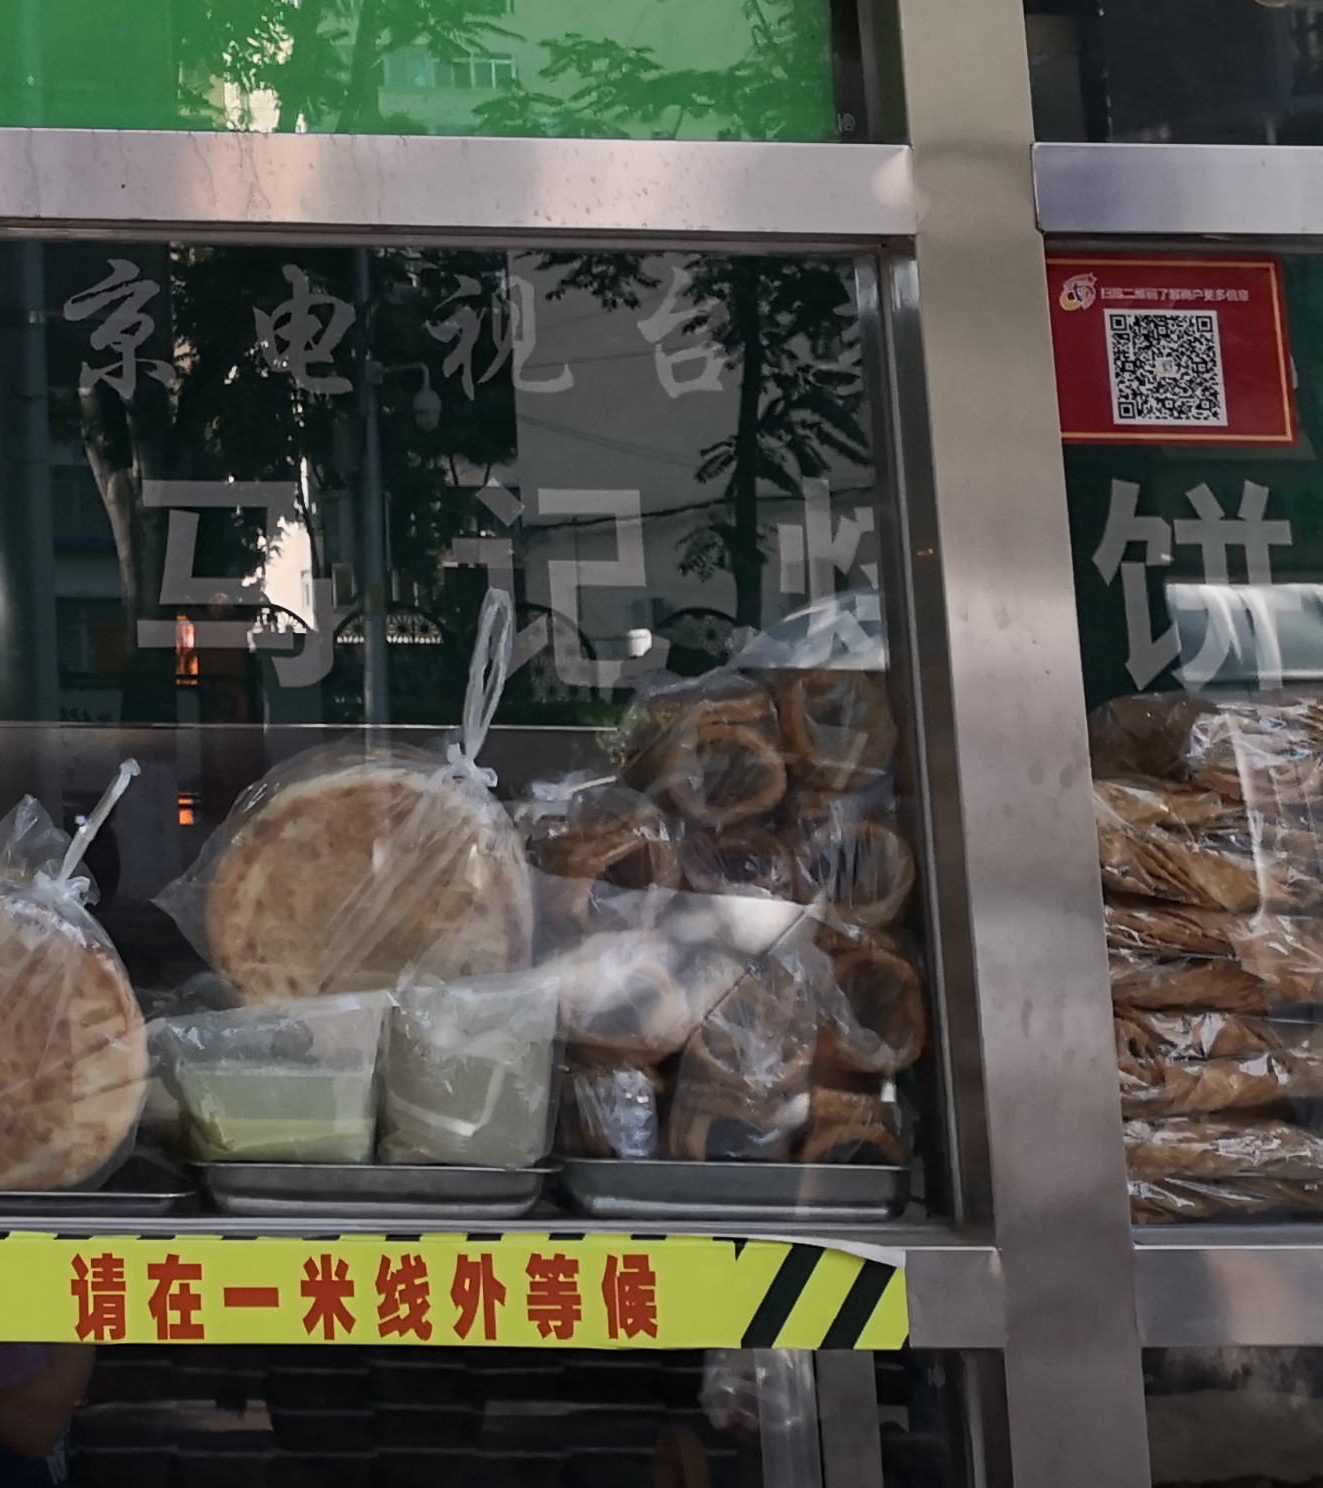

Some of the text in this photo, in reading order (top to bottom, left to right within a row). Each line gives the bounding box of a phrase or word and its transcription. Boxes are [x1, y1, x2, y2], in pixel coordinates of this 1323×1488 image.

[1093, 478, 1301, 692] 饼
[69, 1252, 661, 1342] 请在一米线外等候
